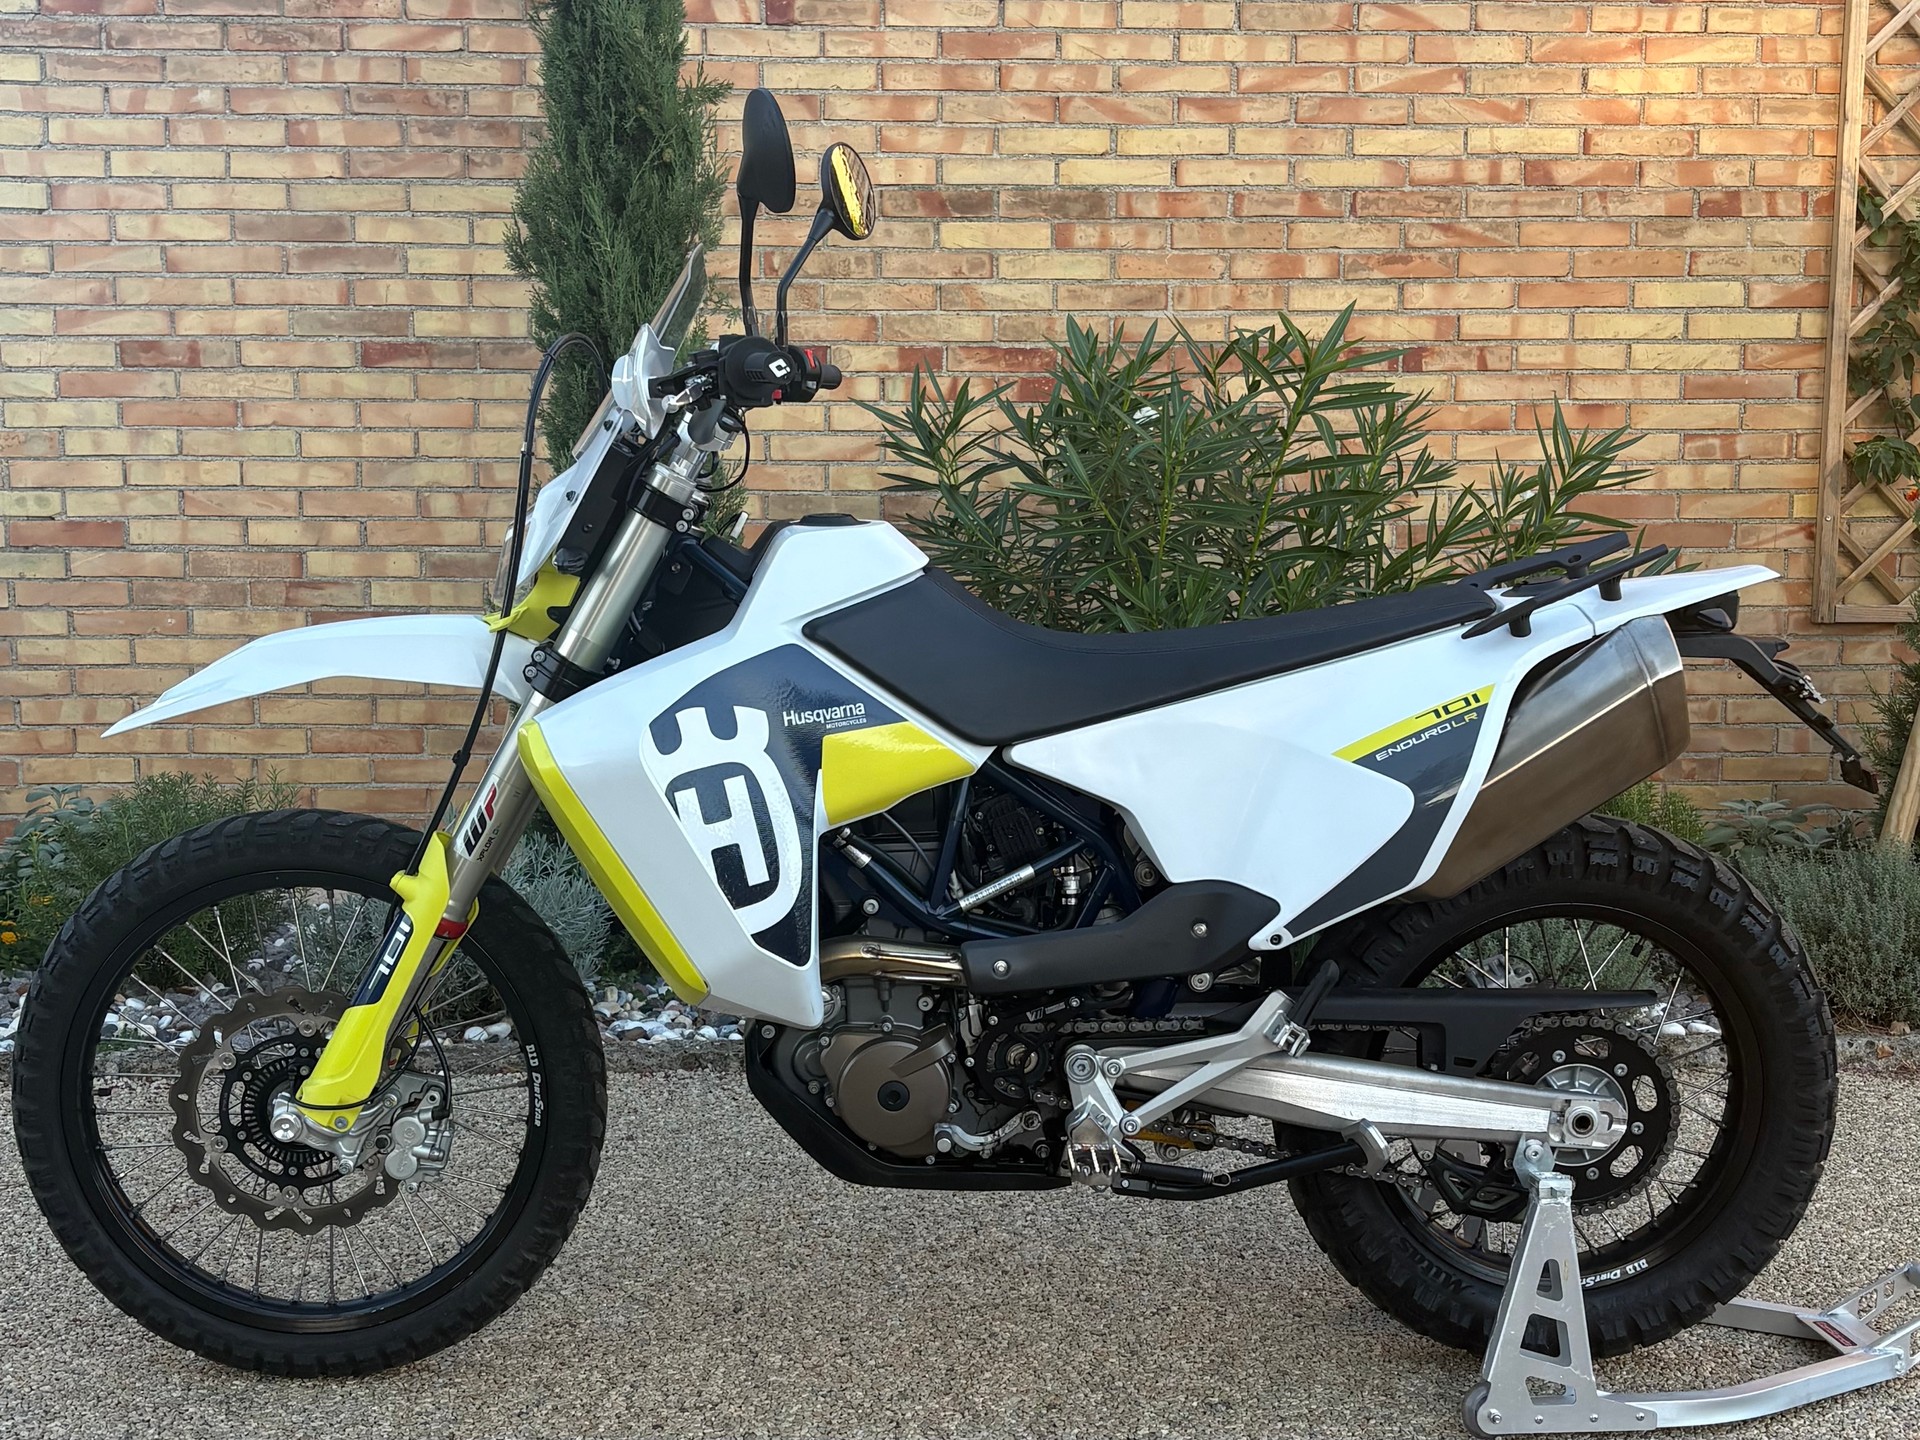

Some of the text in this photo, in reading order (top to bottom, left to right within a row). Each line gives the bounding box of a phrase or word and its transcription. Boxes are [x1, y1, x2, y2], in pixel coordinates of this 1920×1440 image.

[782, 702, 866, 727] Husqvarna
[1414, 692, 1482, 720] 701
[825, 717, 867, 730] MOTORCYCLES
[1375, 711, 1479, 762] ENDURO LR
[462, 782, 498, 858] WP
[476, 836, 496, 862] XPLOR
[368, 920, 412, 990] 701
[1580, 1269, 1621, 1288] DIRTST
